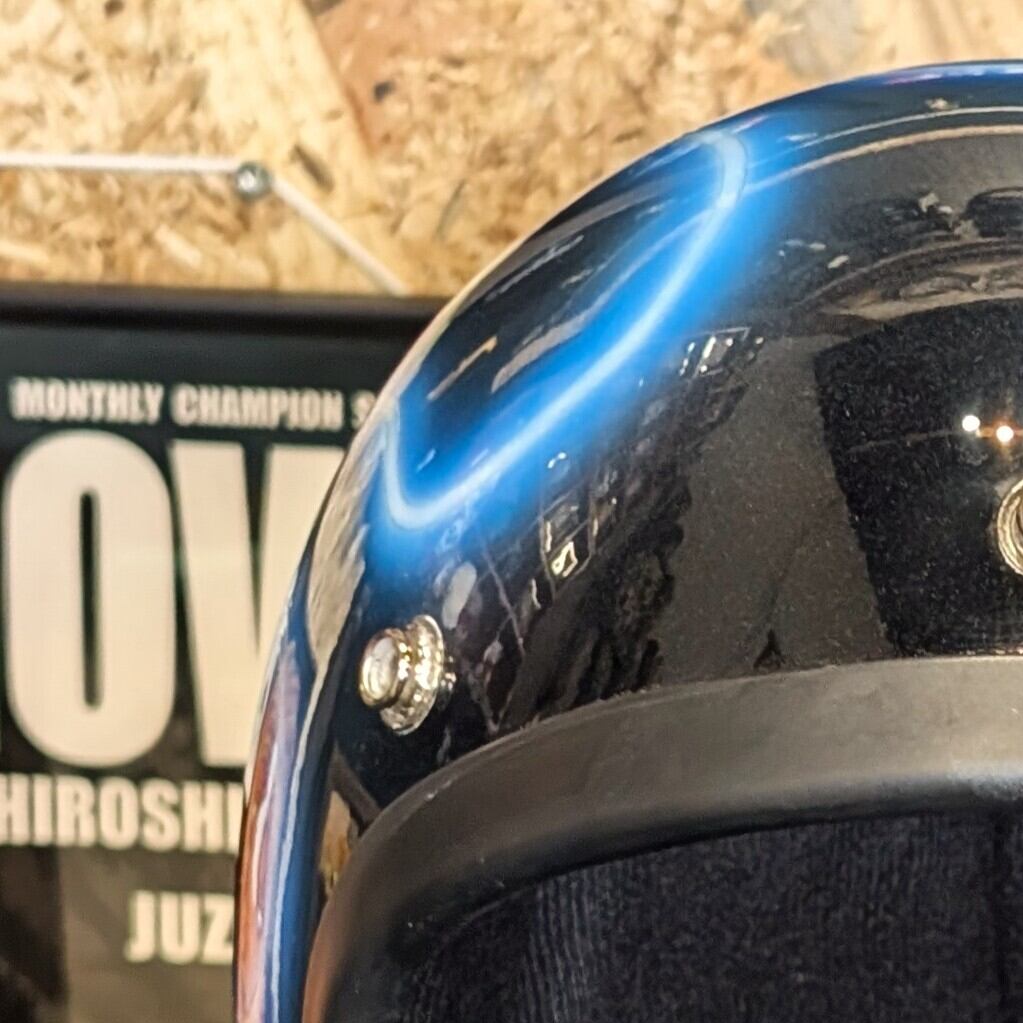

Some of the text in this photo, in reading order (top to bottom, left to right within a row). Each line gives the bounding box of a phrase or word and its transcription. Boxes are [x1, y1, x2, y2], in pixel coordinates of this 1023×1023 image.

[10, 376, 164, 425] MONTHLY
[170, 382, 345, 431] CHAMPION
[0, 772, 244, 855] HIROSHI
[125, 889, 235, 965] JUZ
